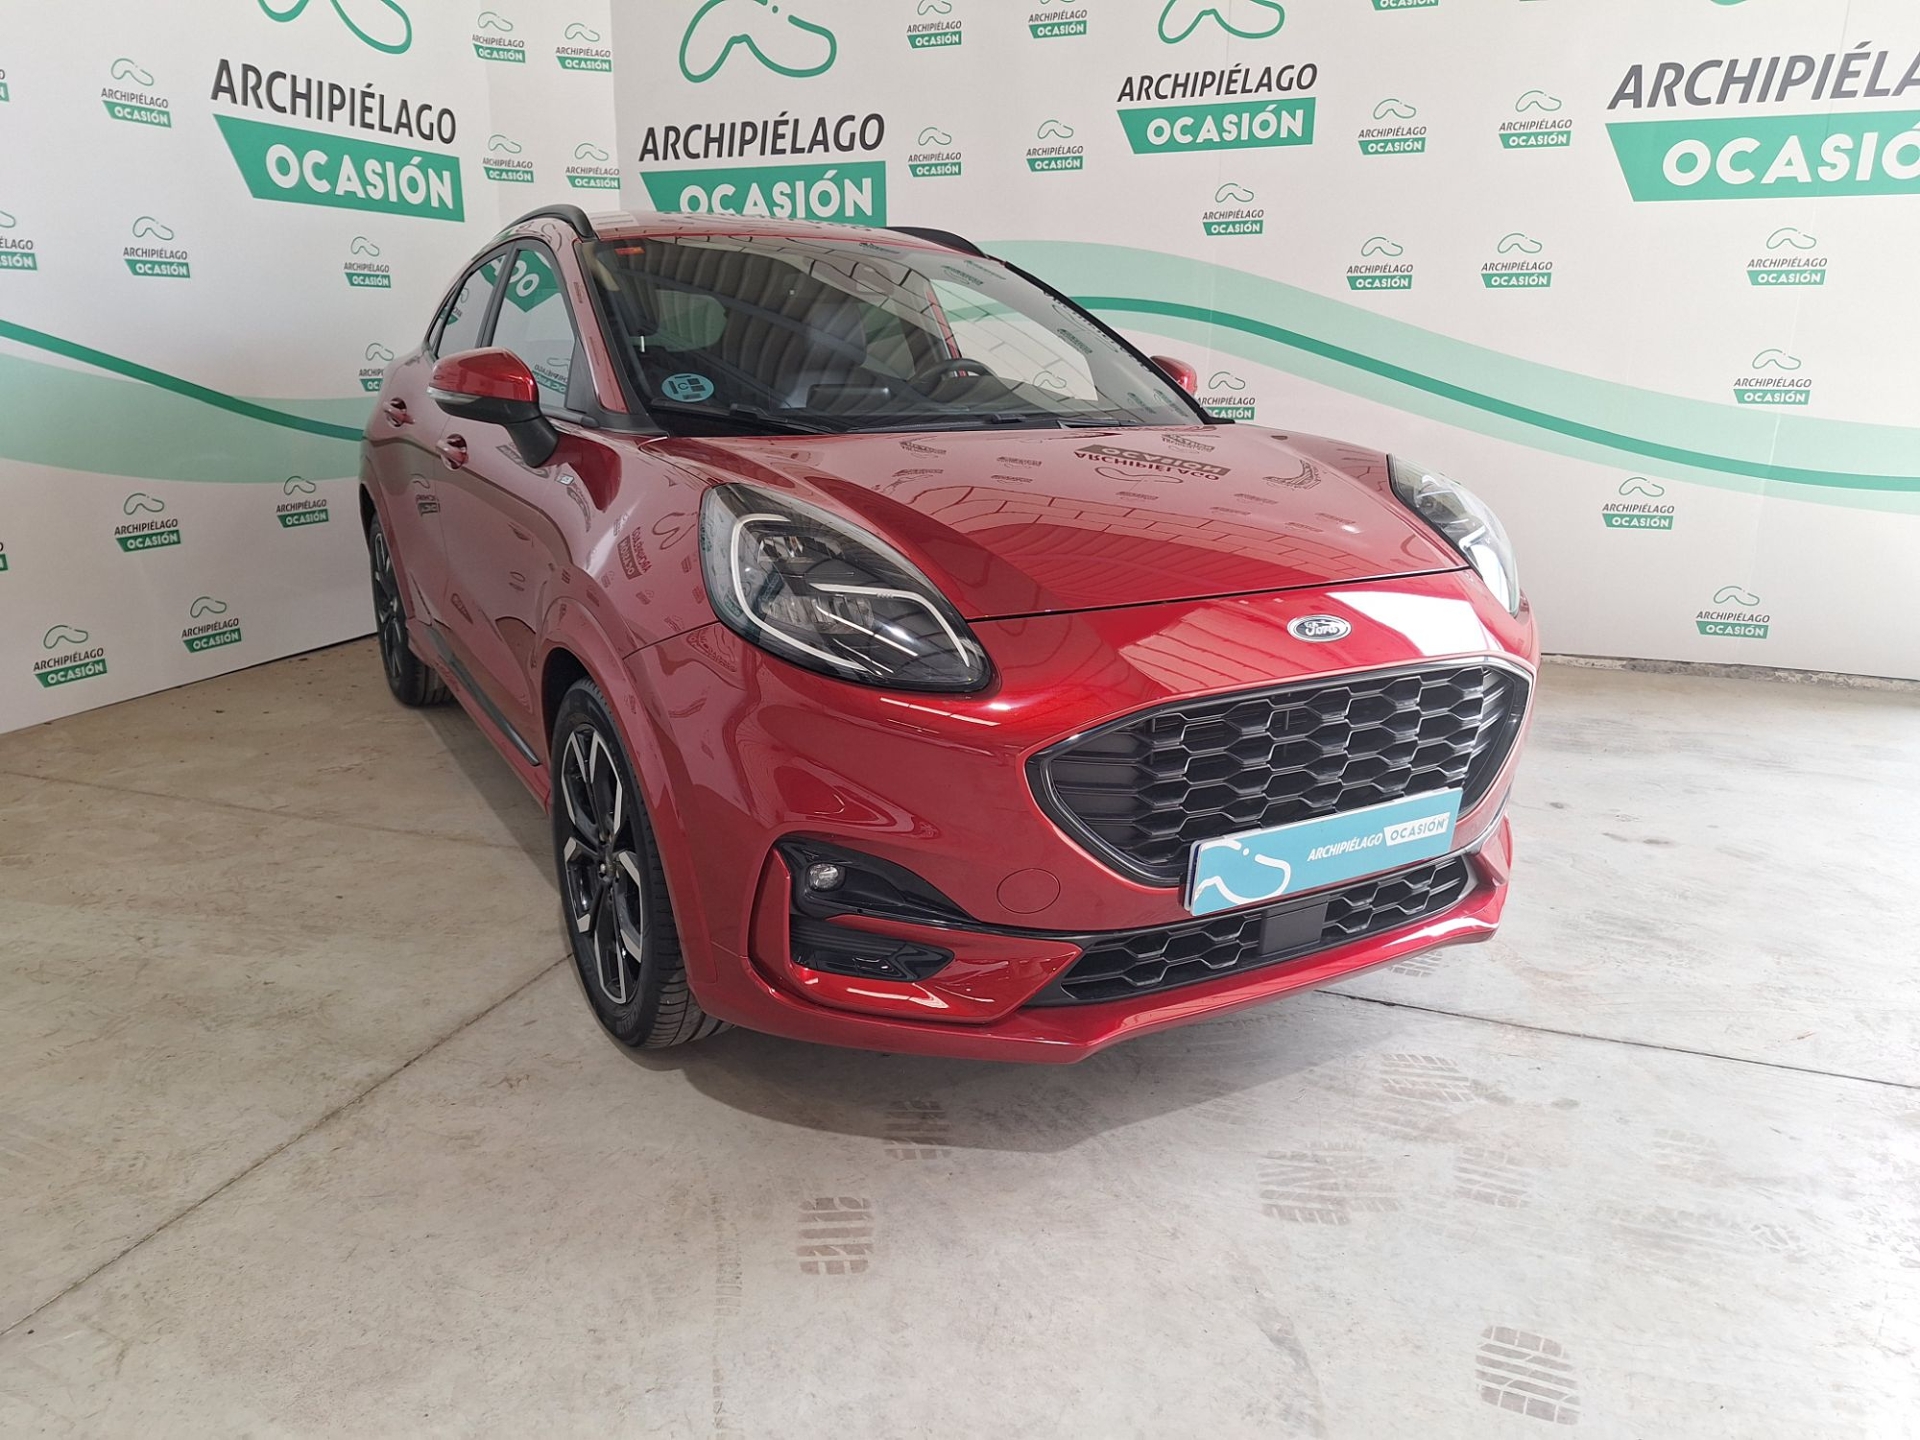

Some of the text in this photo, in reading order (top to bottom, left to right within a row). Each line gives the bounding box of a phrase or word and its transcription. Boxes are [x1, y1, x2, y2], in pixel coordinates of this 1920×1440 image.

[1028, 9, 1087, 23] ARCHIPIÉLAGO
[906, 20, 962, 33] ARCHIPIÉLAGO
[1037, 22, 1084, 37] OCASIÓN
[472, 34, 524, 48] ARCHIPIÉLAGO
[915, 33, 959, 46] OCASIÓN
[478, 48, 523, 61] OCASIÓN
[555, 47, 611, 58] ARCHIPIÉLAGO
[565, 59, 610, 70] OCASIÓN
[1116, 63, 1318, 102] ARCHIPIÉLAGO
[101, 88, 169, 108] ARCHIPIÉLAGO
[210, 58, 456, 144] ARCHIPIÉLAGO
[114, 106, 168, 125] OCASIÓN
[1146, 104, 1304, 145] OCASIÓN
[1498, 118, 1573, 132] ARCHIPIÉLAGO
[638, 111, 885, 162] ARCHIPIÉLAGO
[1358, 126, 1427, 138] ARCHIPIÉLAGO
[1367, 139, 1422, 153] OCASIÓN
[1508, 132, 1567, 147] OCASIÓN
[907, 151, 962, 162] ARCHIPIÉLAGO
[1026, 145, 1084, 157] ARCHIPIÉLAGO
[482, 157, 533, 169] ARCHIPIÉLAGO
[916, 163, 959, 176] OCASIÓN
[1034, 157, 1081, 170] OCASIÓN
[265, 143, 454, 210] OCASIÓN
[488, 170, 532, 181] OCASIÓN
[565, 166, 620, 176] ARCHIPIÉLAGO
[575, 177, 619, 188] OCASIÓN
[679, 169, 872, 219] OCASIÓN
[1202, 209, 1264, 220] ARCHIPIÉLAGO
[1211, 221, 1260, 234] OCASIÓN
[123, 247, 188, 260] ARCHIPIÉLAGO
[136, 261, 187, 276] OCASIÓN
[343, 262, 389, 273] ARCHIPIÉLAGO
[1346, 263, 1414, 274] ARCHIPIÉLAGO
[1481, 261, 1553, 272] ARCHIPIÉLAGO
[1747, 256, 1828, 268] ARCHIPIÉLAGO
[352, 274, 389, 286] OCASIÓN
[1355, 275, 1409, 288] OCASIÓN
[1491, 274, 1548, 286] OCASIÓN
[1757, 271, 1821, 283] OCASIÓN
[1733, 377, 1812, 388] ARCHIPIÉLAGO
[1743, 391, 1805, 403] OCASIÓN
[1209, 408, 1252, 418] CASIÓN
[276, 499, 327, 513] ARCHIPIÉLAGO
[1602, 503, 1675, 514] ARCHIPIÉLAGO
[285, 511, 327, 525] OCASIÓN
[1611, 516, 1670, 528] OCASIÓN
[114, 518, 178, 536] ARCHIPIÉLAGO
[126, 531, 179, 549] OCASIÓN
[1696, 611, 1770, 623] ARCHIPIÉLAGO
[181, 618, 239, 639] ARCHIPIÉLAGO
[1303, 619, 1341, 636] Ford
[1705, 624, 1764, 638] OCASIÓN
[192, 630, 240, 650] OCASIÓN
[33, 647, 104, 672] ARCHIPIÉLAGO
[47, 661, 105, 685] OCASIÓN
[1307, 817, 1446, 861] ARCHIPIÉLAGO OCASIÓN
